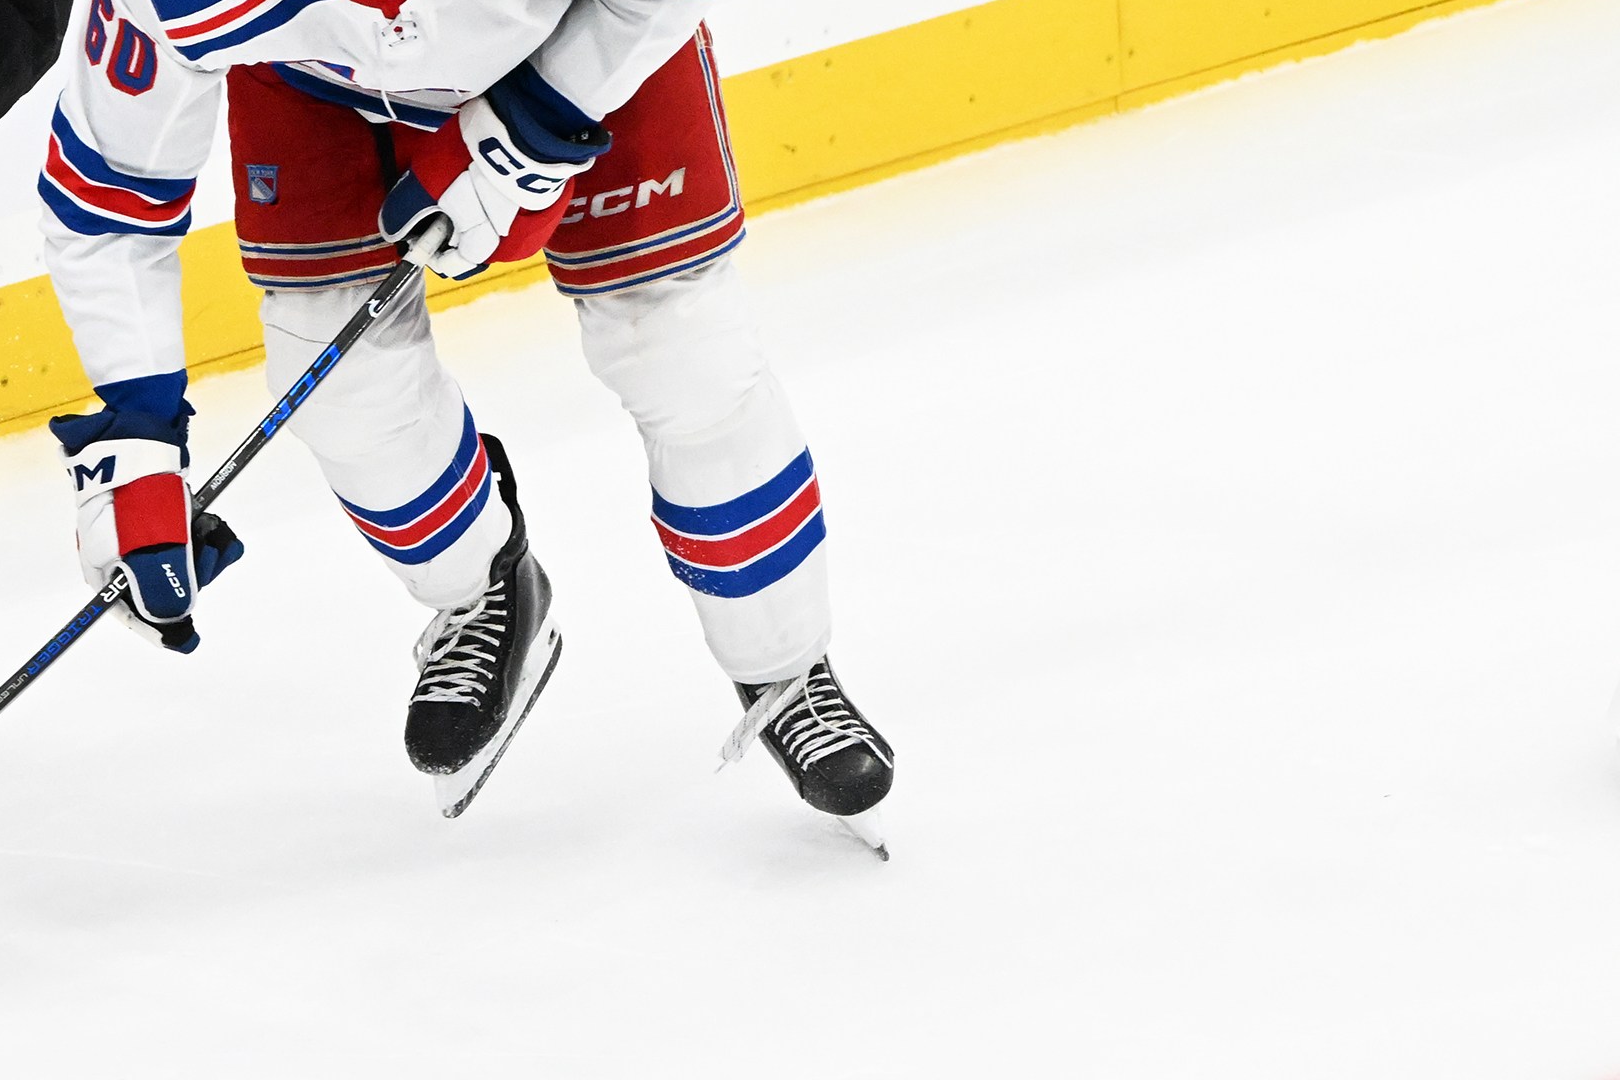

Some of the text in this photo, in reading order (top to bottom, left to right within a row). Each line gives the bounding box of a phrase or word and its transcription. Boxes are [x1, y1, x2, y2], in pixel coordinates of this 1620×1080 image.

[479, 137, 567, 194] CC
[261, 343, 341, 439] CCM
[210, 461, 237, 491] MORROW
[162, 563, 186, 598] CCM
[27, 605, 103, 676] TRIGGER
